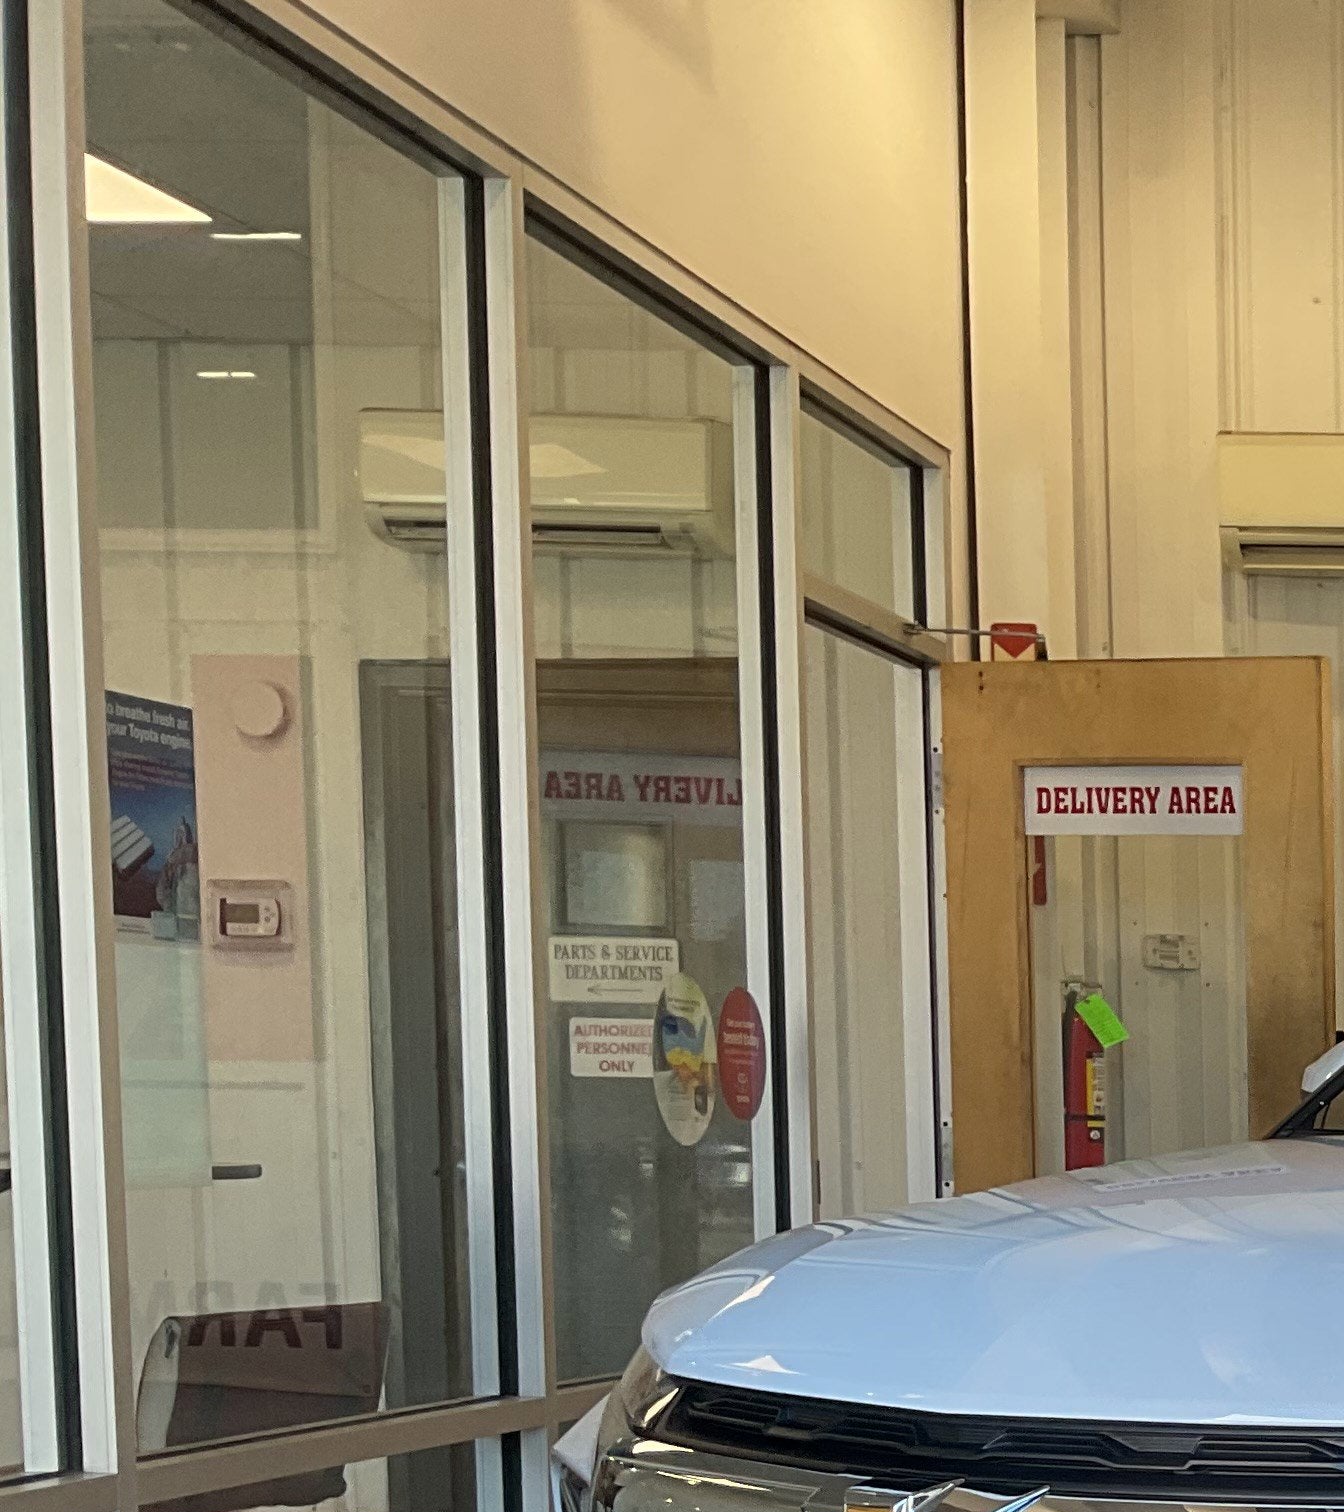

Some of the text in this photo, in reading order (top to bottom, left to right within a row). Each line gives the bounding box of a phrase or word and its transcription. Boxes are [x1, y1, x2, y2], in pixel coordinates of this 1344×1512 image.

[127, 722, 160, 744] Toyota
[1036, 786, 1236, 814] DELIVERY AREA
[553, 944, 675, 962] PARTS & SERVICE
[564, 964, 663, 982] DEPARTMENTS
[576, 1042, 653, 1055] PERSONNE
[598, 1060, 635, 1072] ONLY
